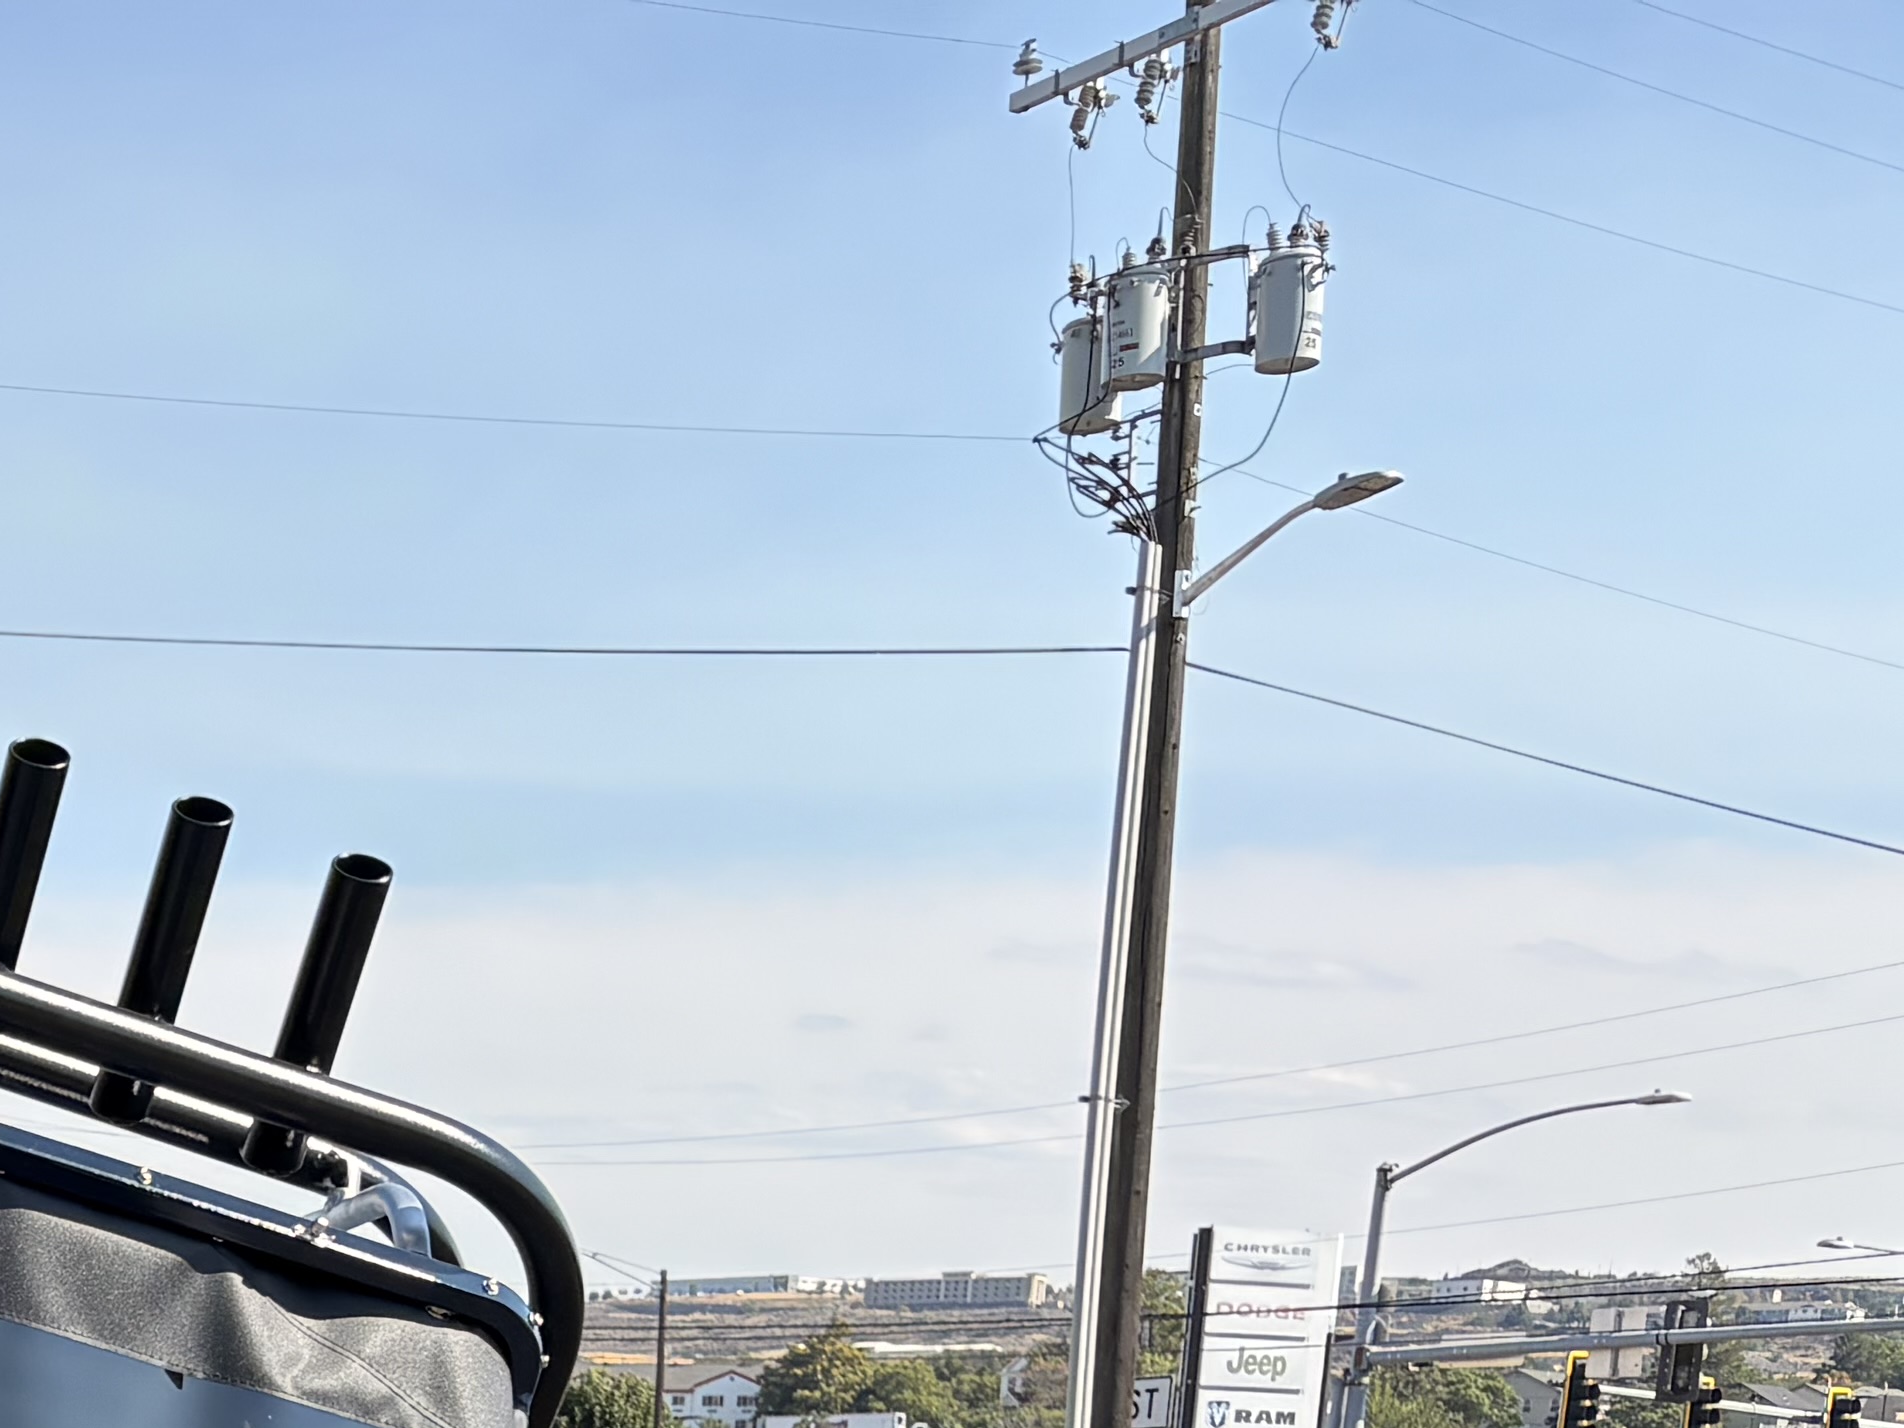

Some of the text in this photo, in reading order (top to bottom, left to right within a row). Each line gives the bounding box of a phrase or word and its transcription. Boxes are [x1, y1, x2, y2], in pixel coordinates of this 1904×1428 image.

[1224, 1242, 1311, 1257] CHRYSLER
[1216, 1302, 1306, 1320] DODGE
[1226, 1346, 1287, 1382] Jeep
[1130, 1388, 1160, 1420] ST
[1234, 1408, 1296, 1426] RAM
